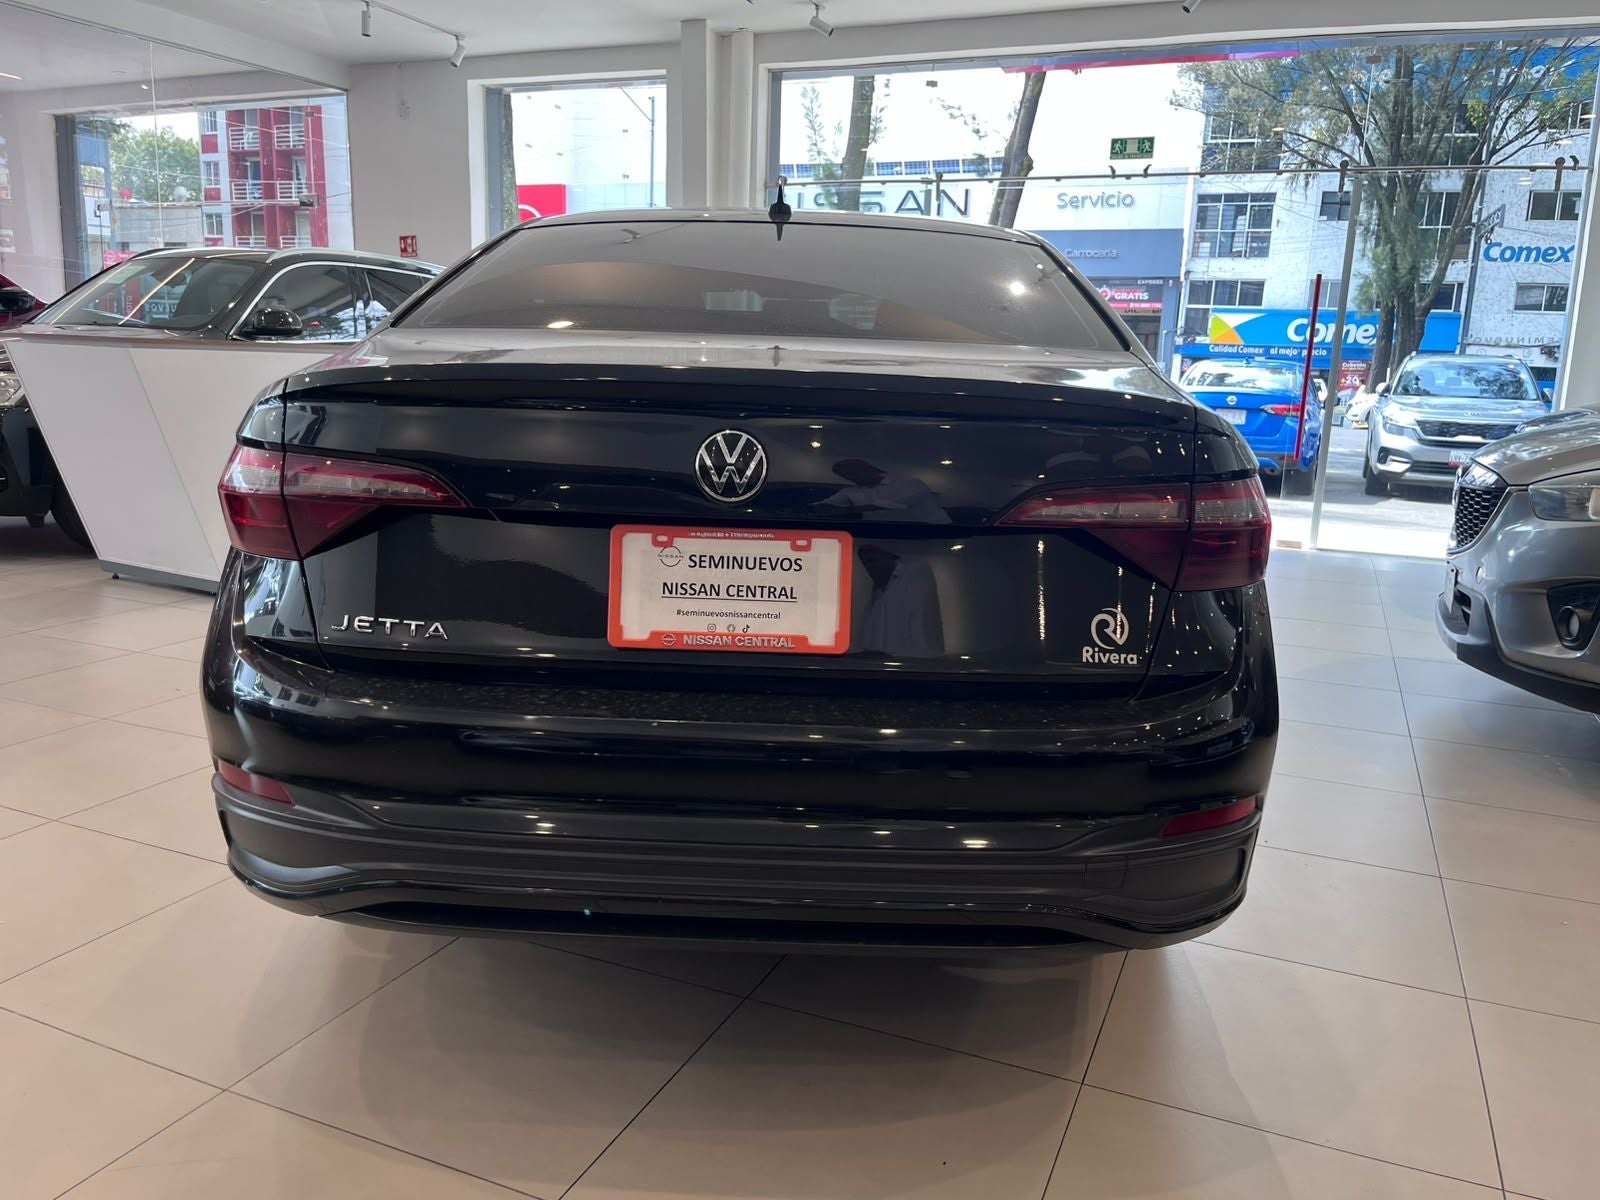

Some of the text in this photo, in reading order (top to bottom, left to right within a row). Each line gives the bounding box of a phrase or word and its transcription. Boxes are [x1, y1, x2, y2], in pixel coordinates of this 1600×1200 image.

[1057, 191, 1135, 209] Servicio
[1484, 242, 1575, 263] Comex
[1114, 292, 1149, 300] GRATIS
[1287, 317, 1378, 346] Come
[1209, 344, 1327, 357] Calidad Comex al mejo pcio
[688, 554, 803, 572] SEMINUEVOS
[662, 582, 797, 600] NISSAN CENTRAL
[676, 608, 781, 620] #seminuevosnissancentral
[331, 614, 448, 640] JETTA
[683, 634, 796, 648] NISSAN CENTRAL
[1082, 646, 1138, 665] Rivera
